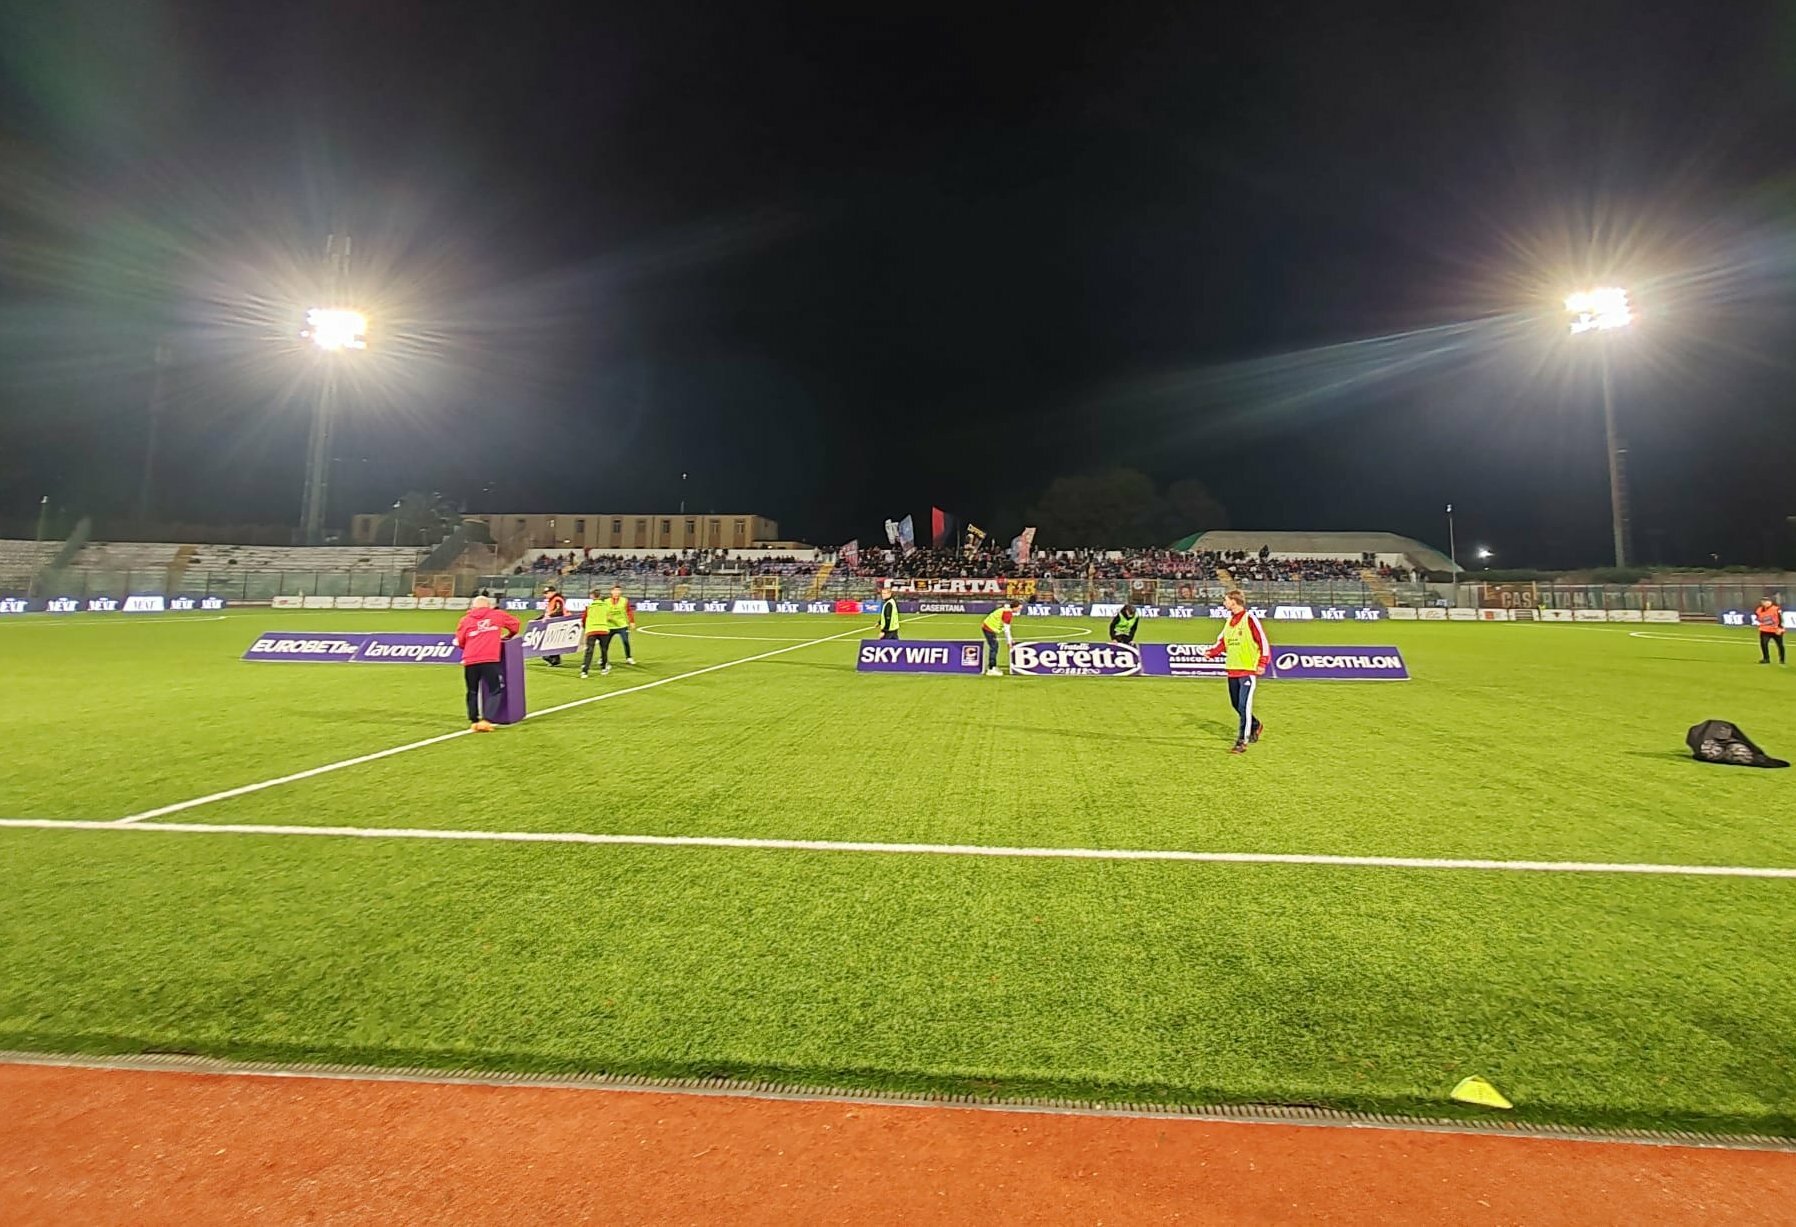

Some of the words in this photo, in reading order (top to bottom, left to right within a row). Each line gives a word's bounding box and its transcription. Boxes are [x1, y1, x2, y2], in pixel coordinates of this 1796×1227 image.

[920, 604, 965, 612] CASERTANA
[522, 627, 545, 650] sky
[861, 647, 902, 664] SKY
[905, 647, 948, 664] WIFI
[1016, 648, 1138, 668] Beretta
[1301, 655, 1401, 669] DECATHLON
